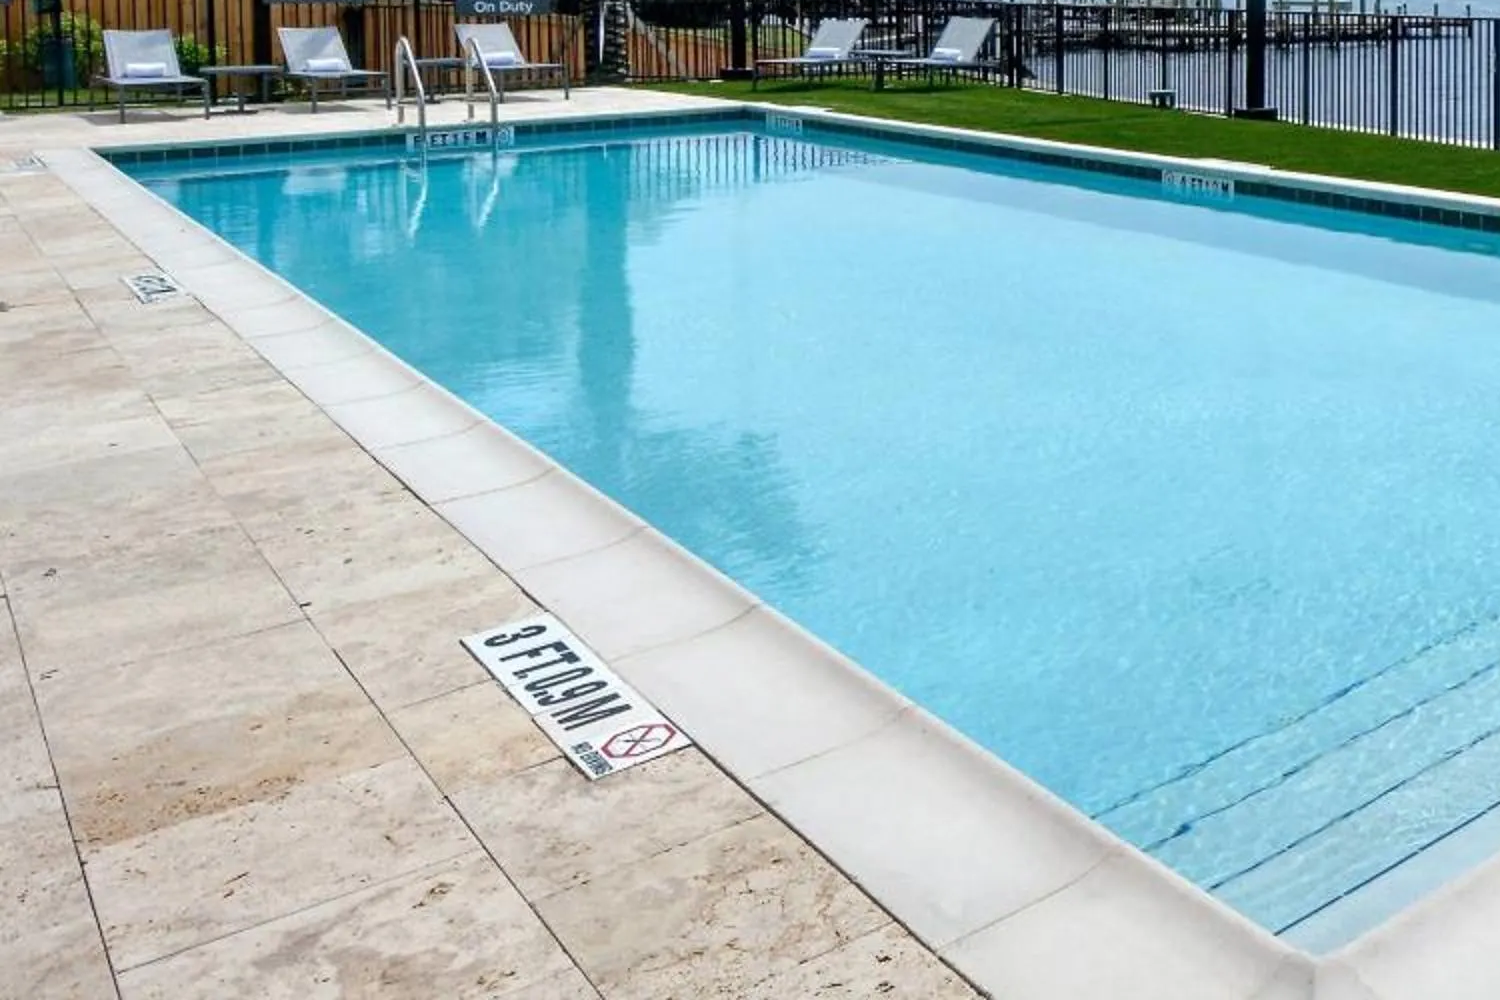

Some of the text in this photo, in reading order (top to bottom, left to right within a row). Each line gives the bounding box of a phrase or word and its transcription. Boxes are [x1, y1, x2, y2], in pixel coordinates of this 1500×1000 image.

[474, 1, 533, 13] On Duty
[484, 624, 547, 647] 3
